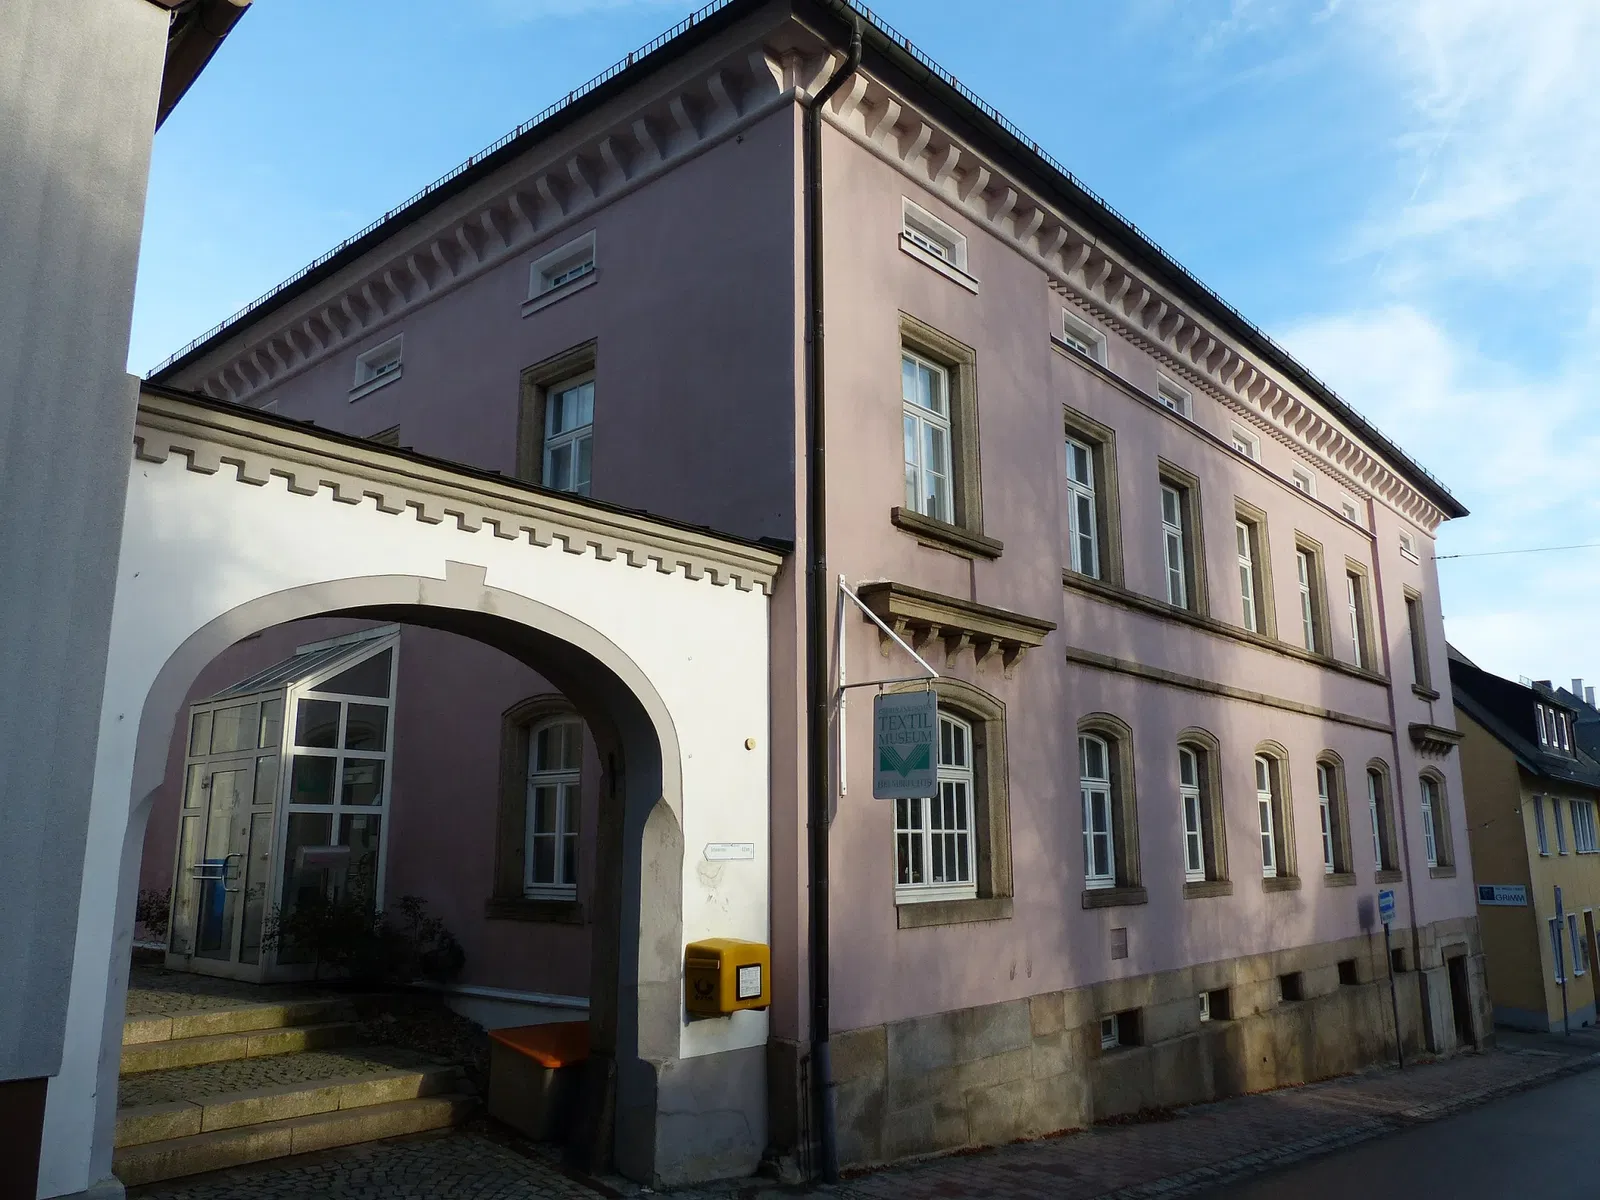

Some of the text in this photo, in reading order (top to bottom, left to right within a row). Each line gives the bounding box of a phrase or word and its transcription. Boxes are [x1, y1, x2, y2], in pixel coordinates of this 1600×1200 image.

[878, 713, 932, 731] TEXTIL
[878, 731, 932, 745] MUSEUM
[1495, 893, 1525, 902] GRIMM
